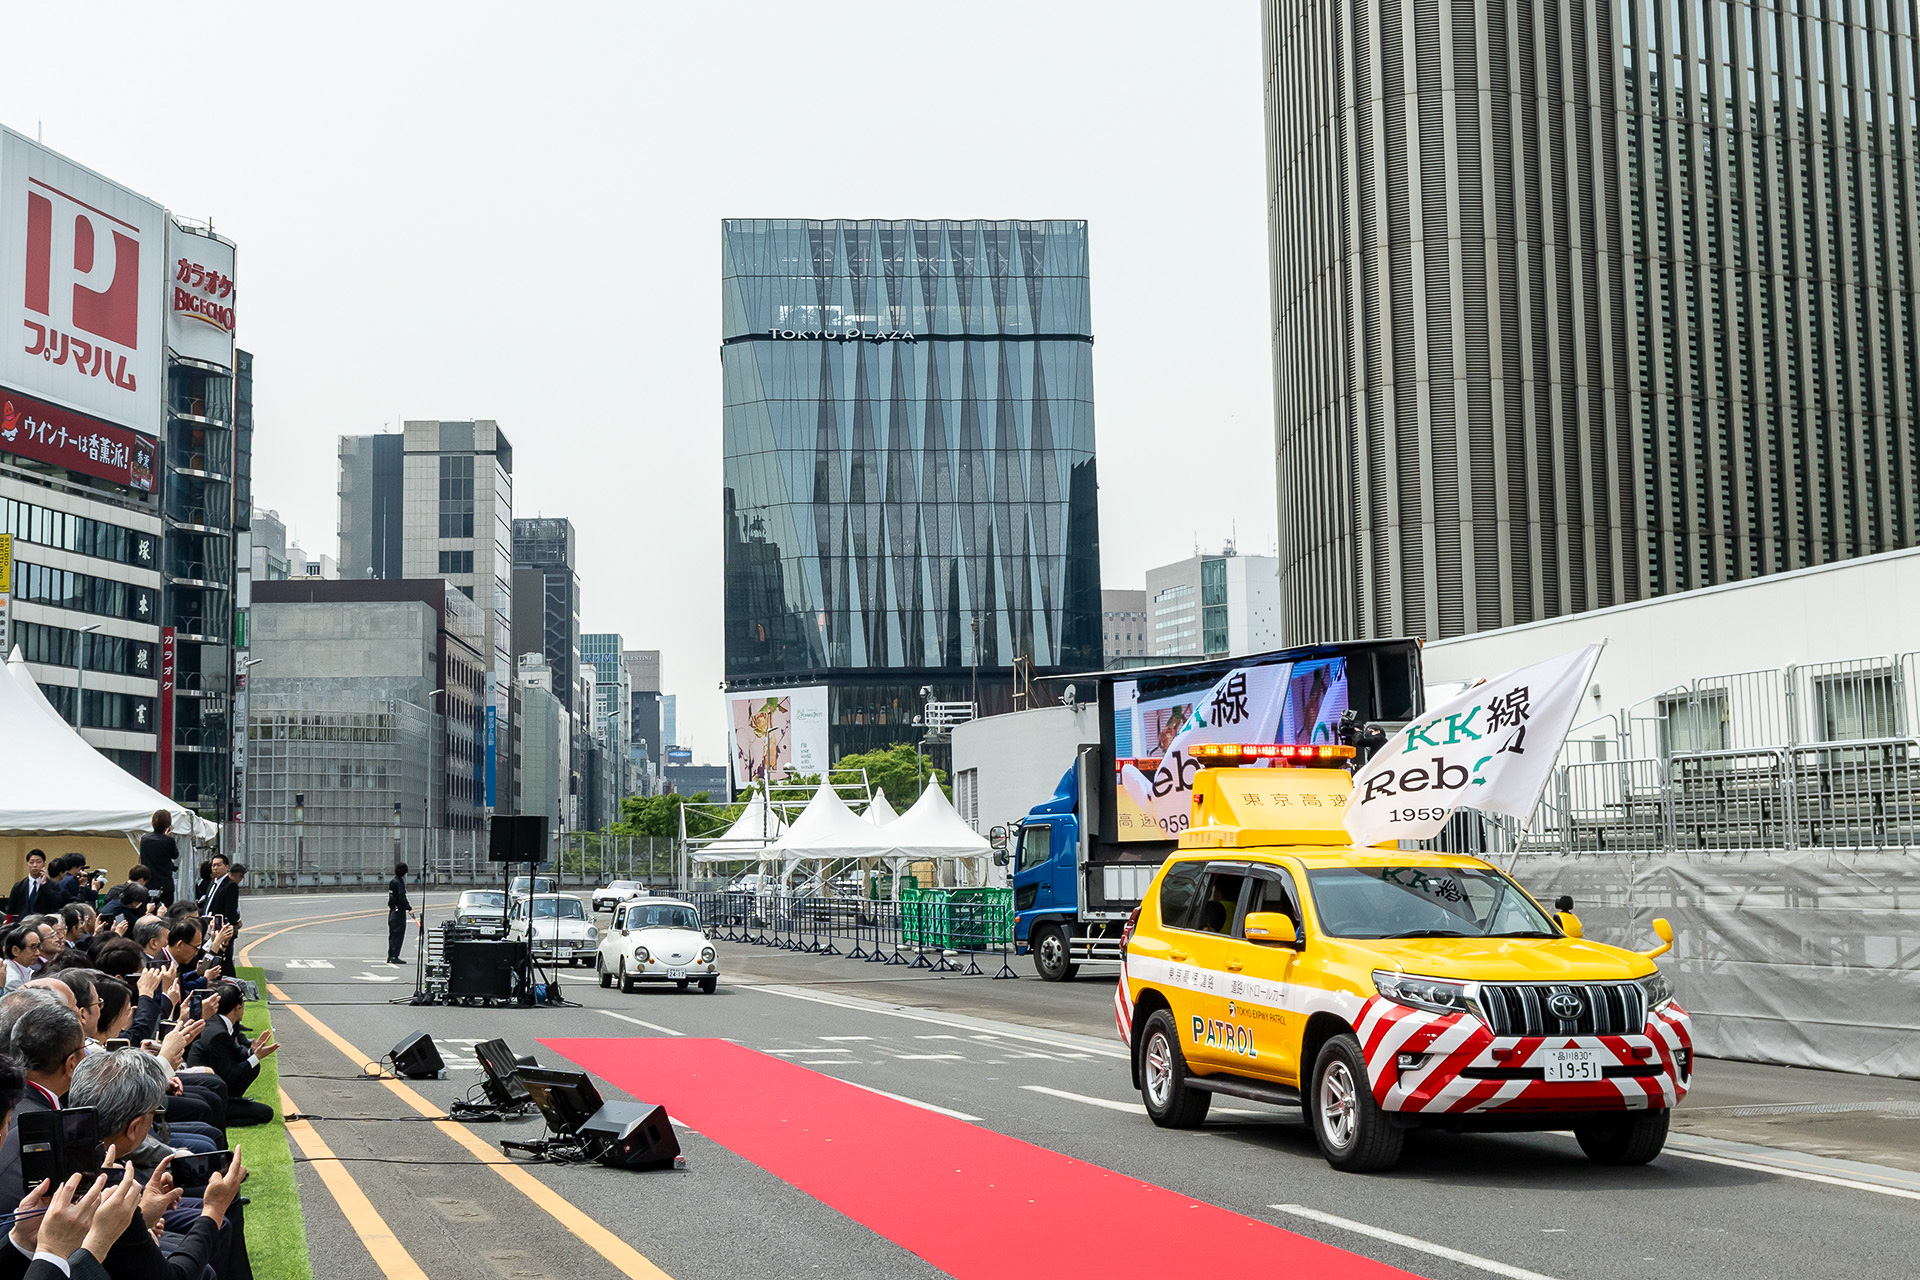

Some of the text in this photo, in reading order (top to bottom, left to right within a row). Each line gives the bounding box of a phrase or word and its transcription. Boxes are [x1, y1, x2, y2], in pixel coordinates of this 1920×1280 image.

[177, 258, 234, 298] カラオケ
[174, 286, 236, 331] BIG ECHO
[768, 327, 915, 340] TOKYU PLAZA
[24, 319, 137, 392] プリマハム
[163, 635, 174, 691] カラオケ
[1402, 686, 1531, 755] KK線
[1389, 807, 1445, 823] 1959
[1192, 1015, 1258, 1059] PATROL
[1237, 1006, 1252, 1018] TOKYO
[1269, 1013, 1287, 1026] PATROL
[1560, 1062, 1597, 1079] 19-51
